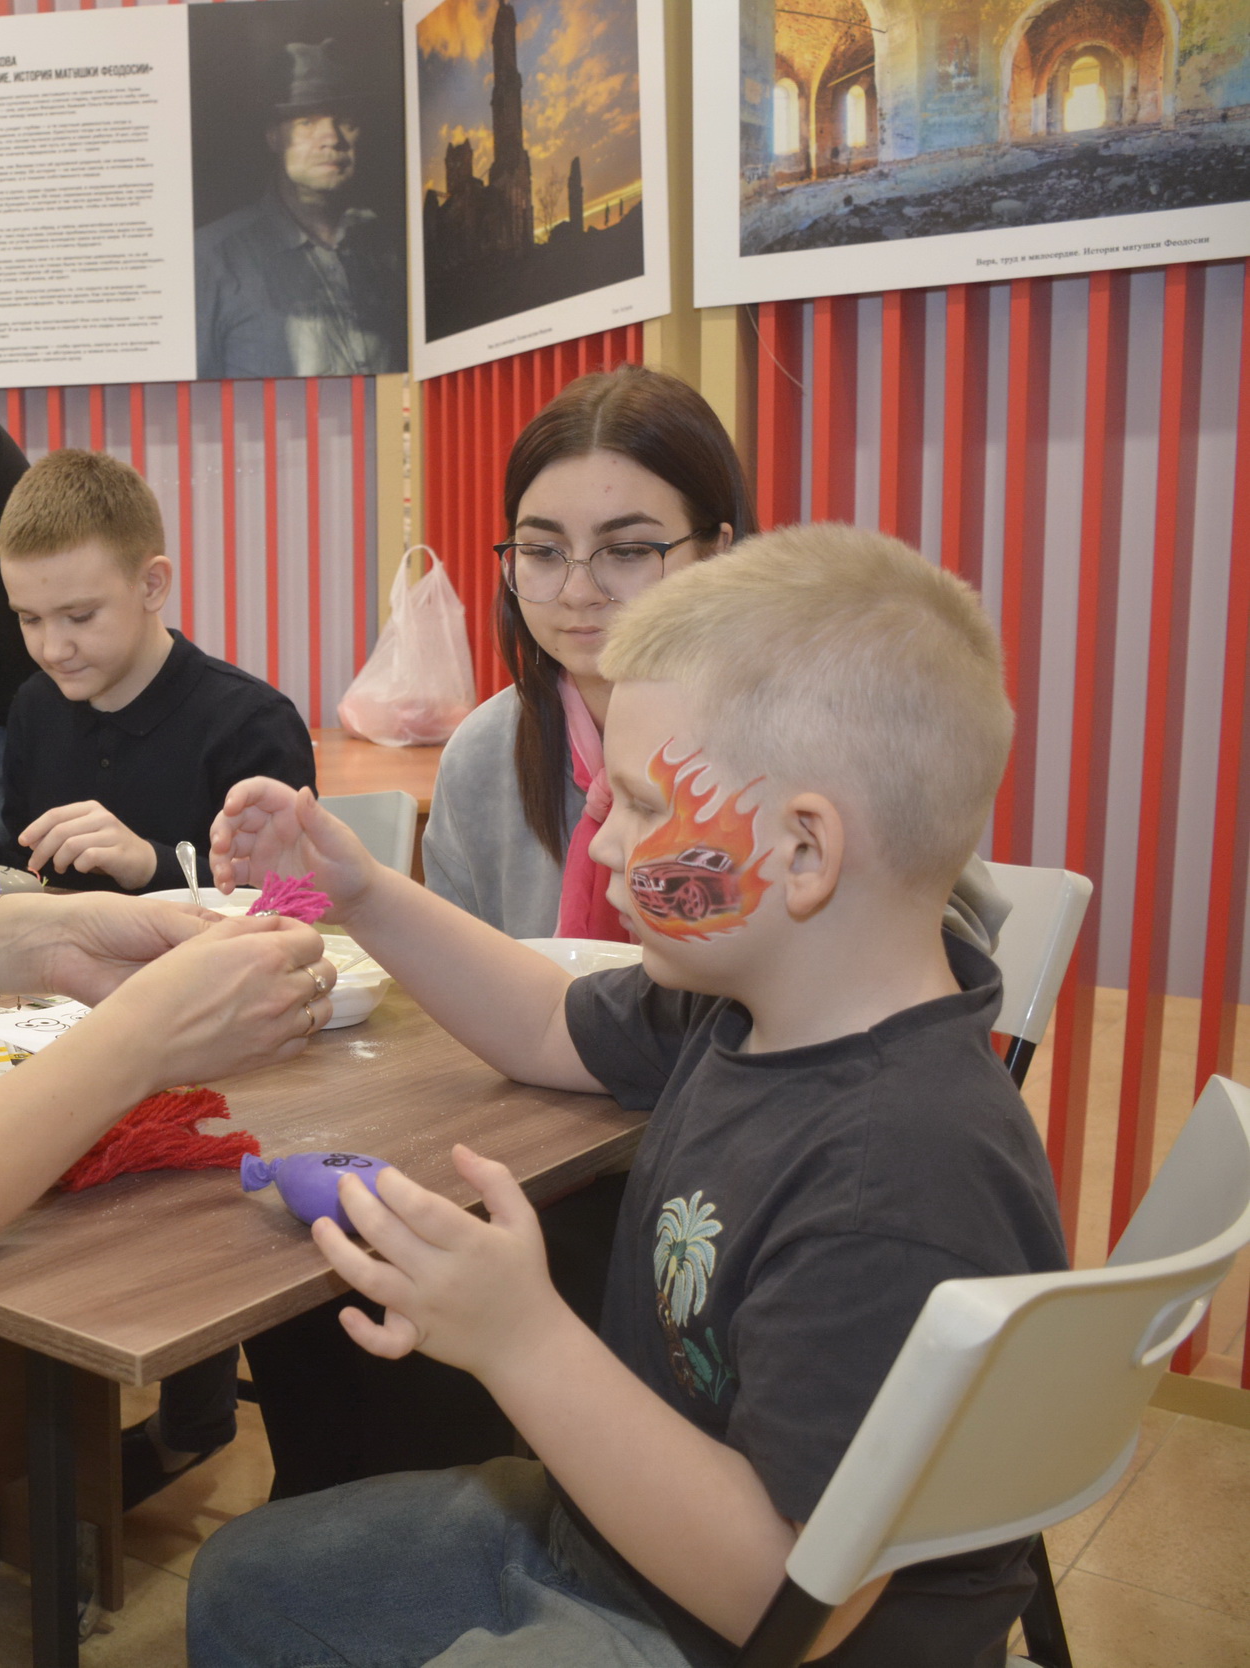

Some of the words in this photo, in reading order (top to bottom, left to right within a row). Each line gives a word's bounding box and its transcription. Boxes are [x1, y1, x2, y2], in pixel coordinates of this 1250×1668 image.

[13, 69, 52, 82] ИСТОРИЯ
[54, 66, 99, 79] МАТУШКИ
[1000, 256, 1018, 265] труд
[1083, 244, 1119, 255] История
[1122, 241, 1161, 252] матушки
[1164, 236, 1210, 247] Феодосии
